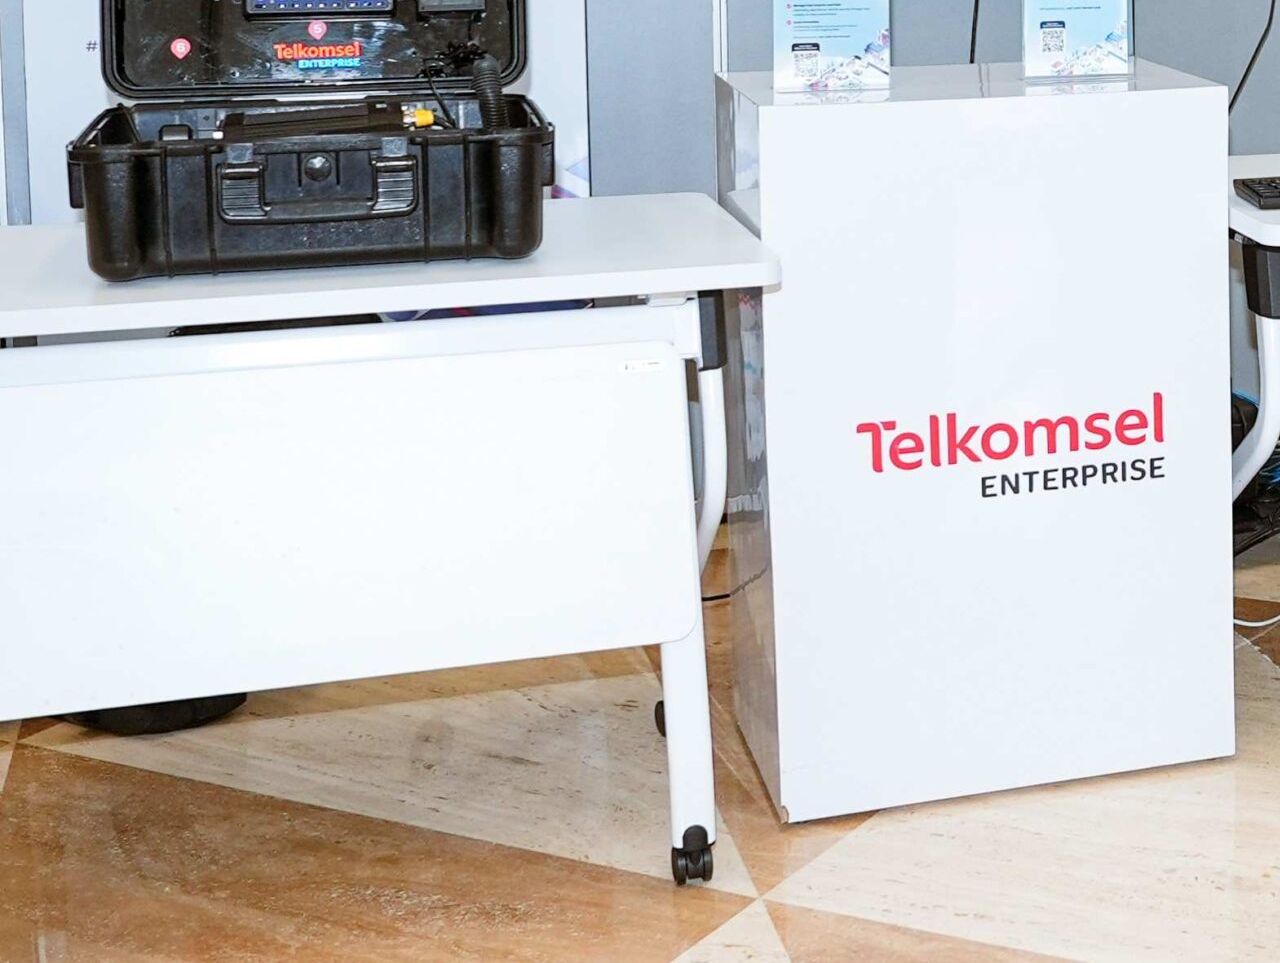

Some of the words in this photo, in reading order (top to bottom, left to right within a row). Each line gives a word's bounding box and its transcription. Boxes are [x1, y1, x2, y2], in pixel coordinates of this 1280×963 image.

[314, 24, 322, 33] 5
[177, 43, 186, 52] 6
[273, 40, 363, 60] Telkomsel
[297, 58, 361, 69] ENTERPRISE
[856, 392, 1165, 473] Telkomsel
[981, 456, 1166, 498] ENTERPRISE
